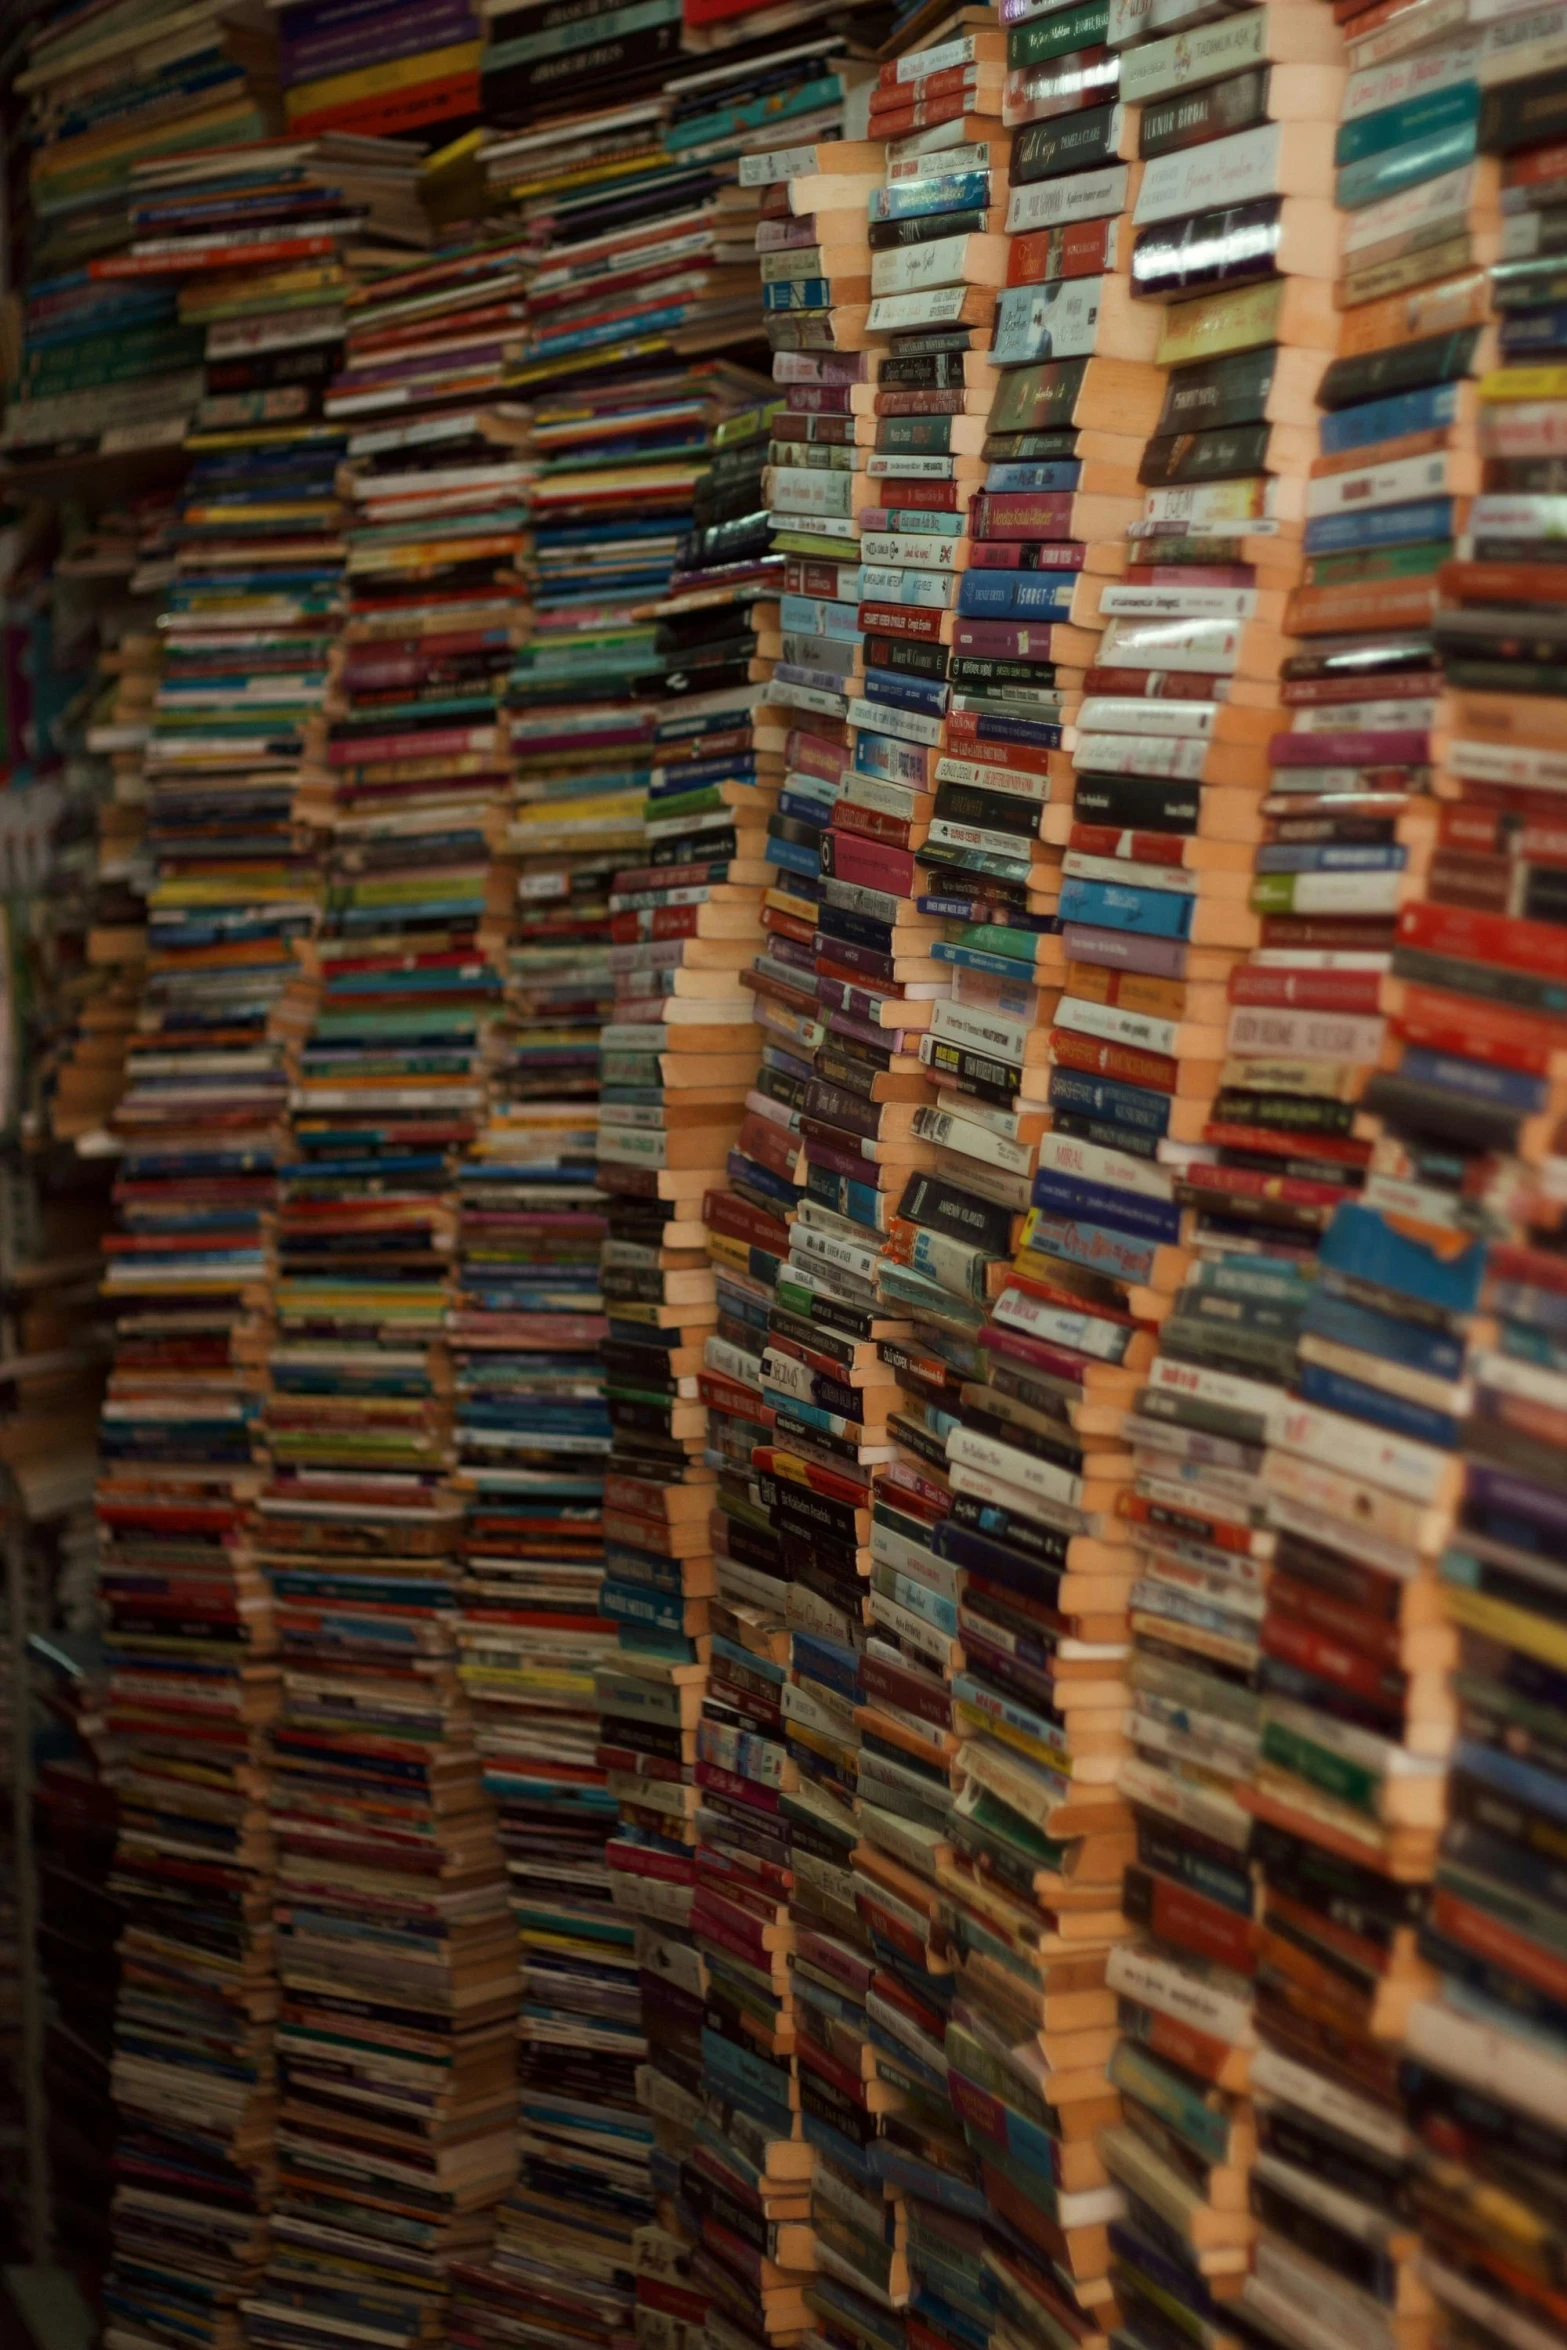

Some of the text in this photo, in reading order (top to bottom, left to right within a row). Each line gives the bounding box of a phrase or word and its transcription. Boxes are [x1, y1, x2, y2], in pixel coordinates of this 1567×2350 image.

[1060, 130, 1081, 150] PAMELA
[1082, 126, 1101, 144] CLARE
[883, 1346, 893, 1364] ÖLÜ
[893, 1352, 908, 1370] KÖPEK
